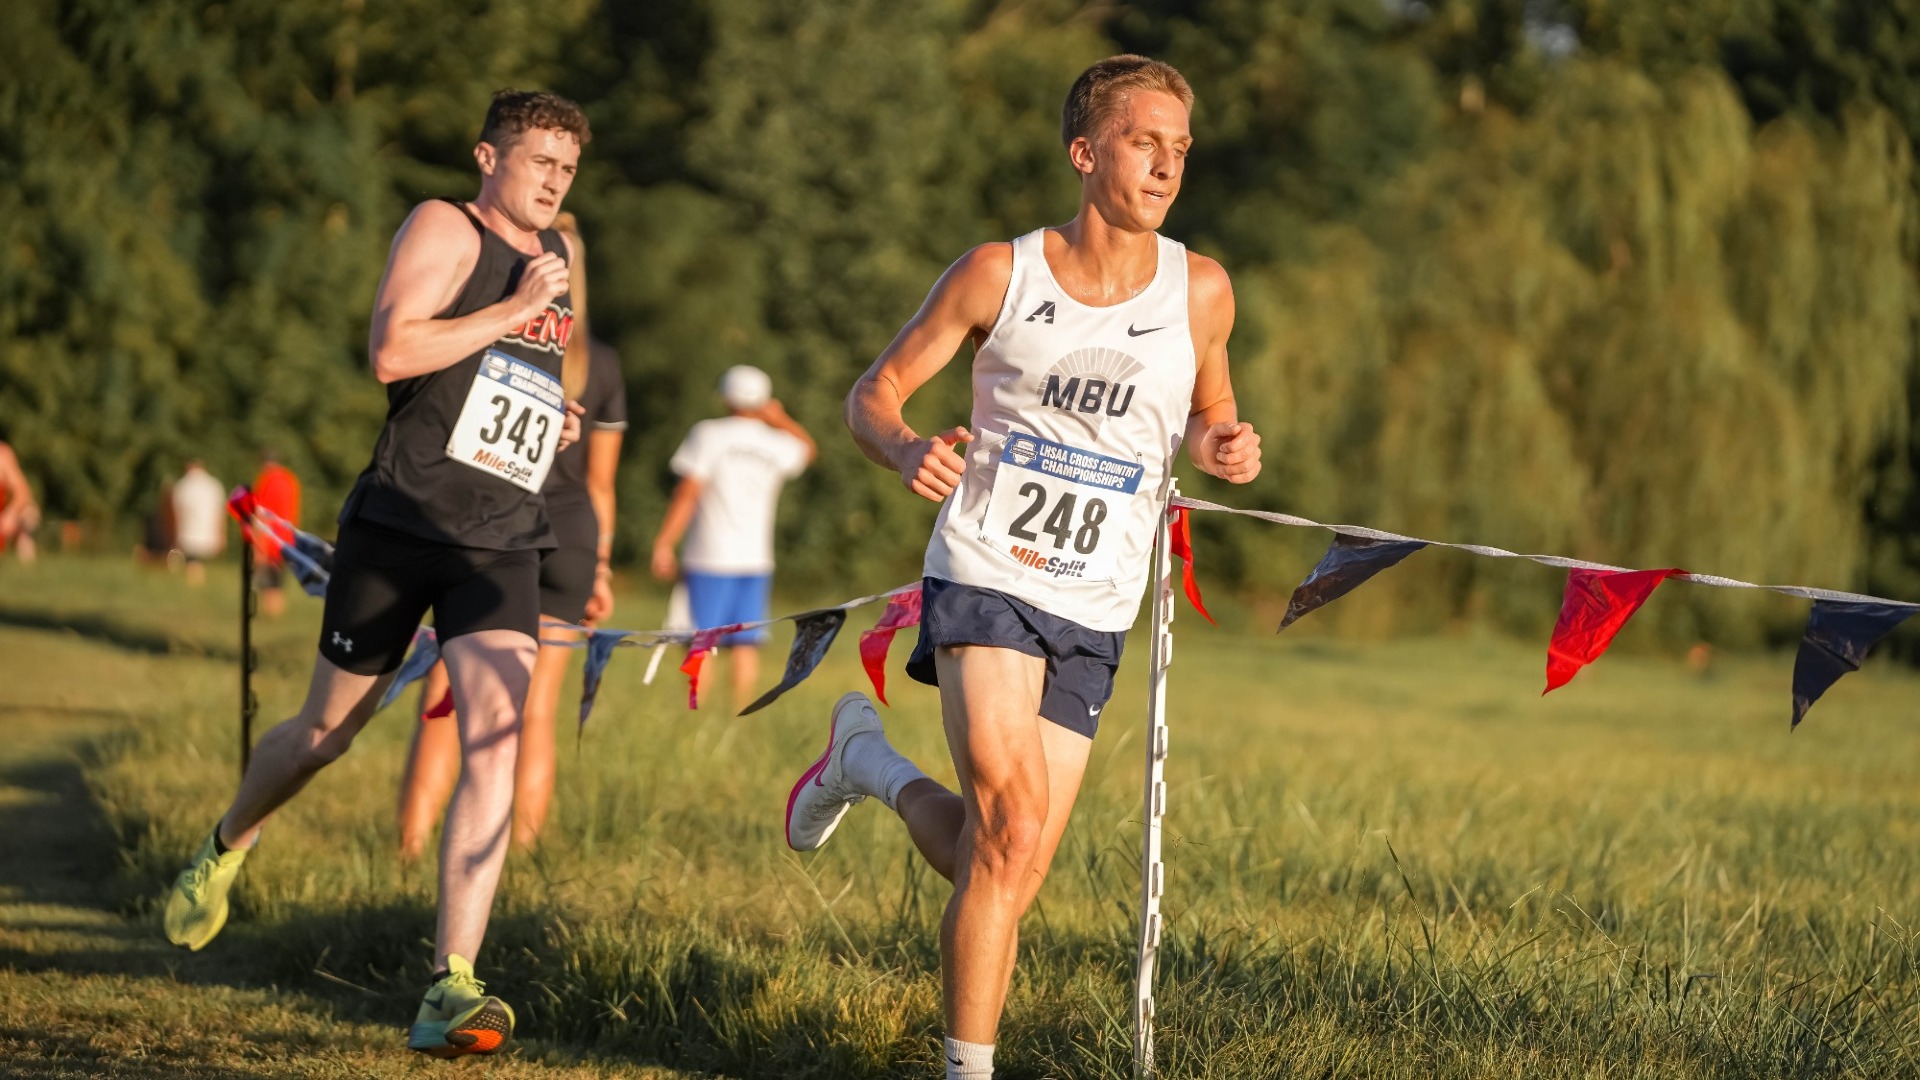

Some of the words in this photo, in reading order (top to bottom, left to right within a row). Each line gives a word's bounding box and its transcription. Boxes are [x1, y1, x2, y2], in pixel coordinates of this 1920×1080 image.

[1041, 374, 1136, 417] MBU
[479, 394, 550, 464] 343
[1039, 443, 1068, 463] LHSAA
[1069, 452, 1099, 470] CROSS
[1099, 460, 1139, 479] COUNTRY
[1041, 458, 1126, 489] CHAMPIONSHIPS
[1008, 481, 1107, 555] 248
[1009, 544, 1087, 578] MileSplit
